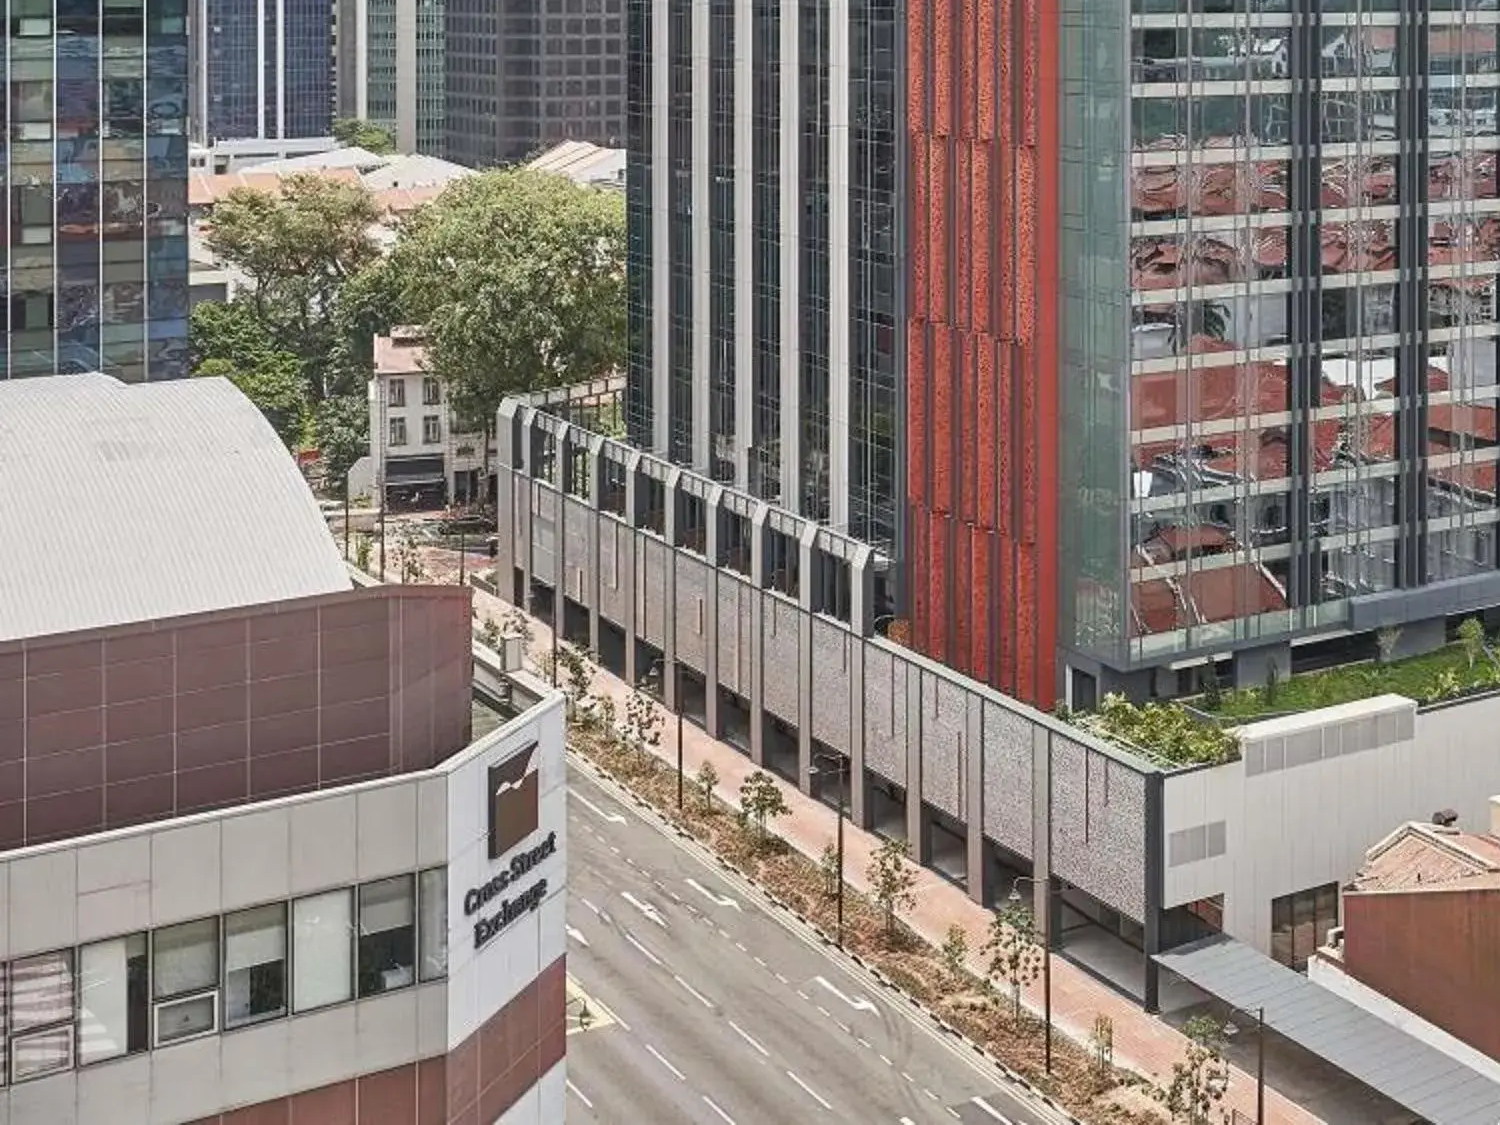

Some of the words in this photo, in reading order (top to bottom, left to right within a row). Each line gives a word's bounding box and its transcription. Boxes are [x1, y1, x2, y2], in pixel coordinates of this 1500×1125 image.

[464, 870, 510, 917] Cross
[510, 831, 557, 882] Street
[474, 878, 548, 950] Exchange
